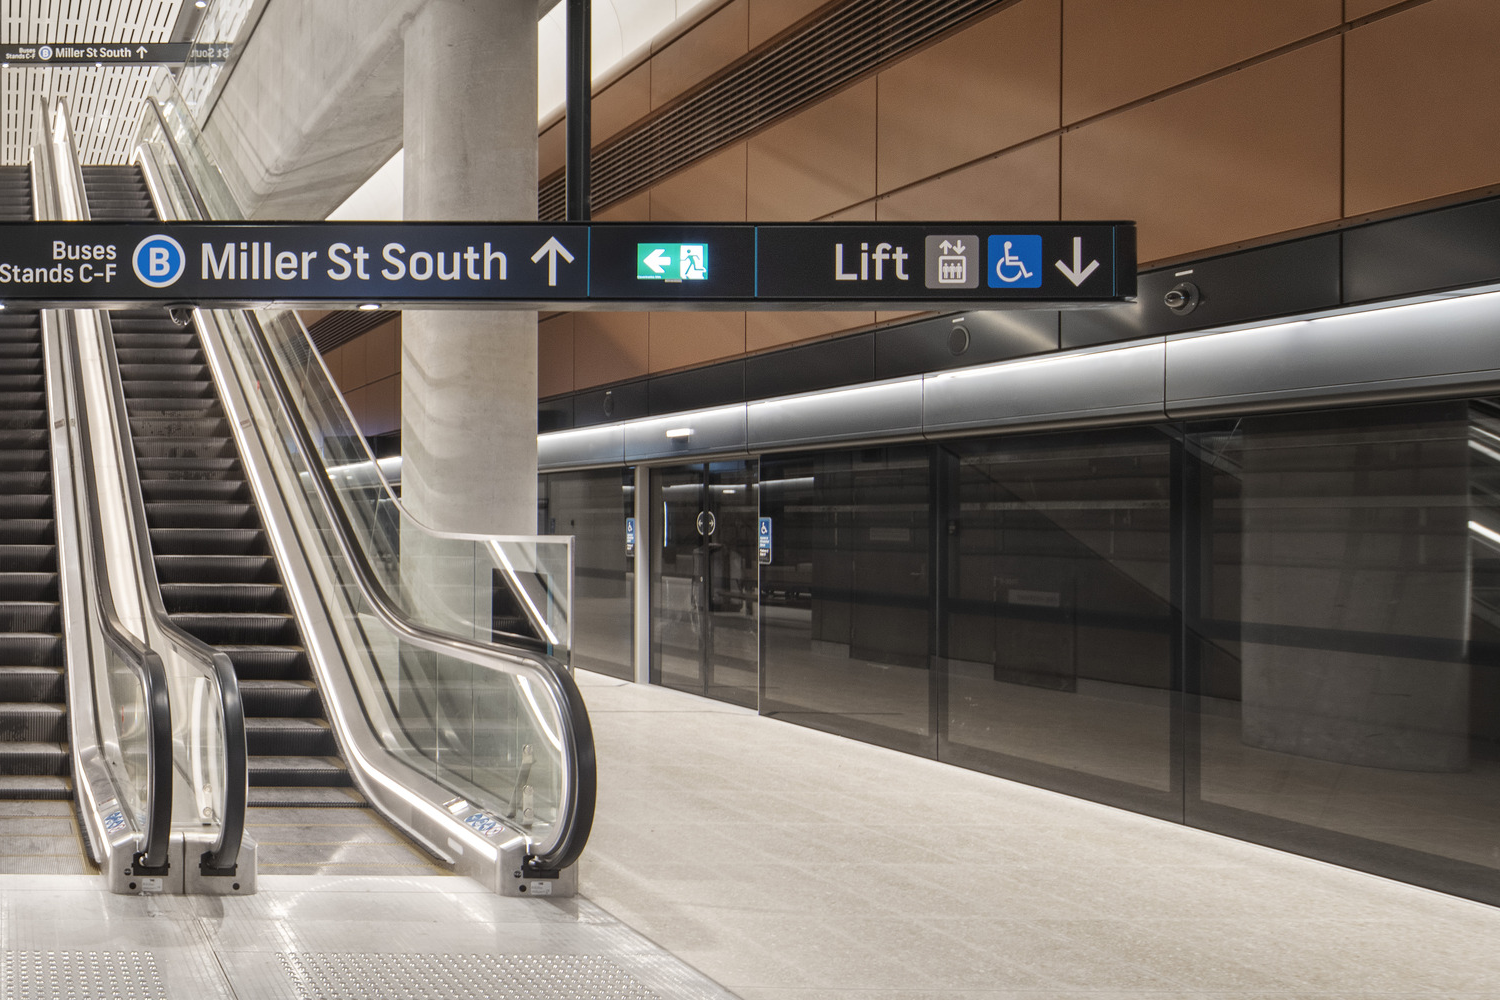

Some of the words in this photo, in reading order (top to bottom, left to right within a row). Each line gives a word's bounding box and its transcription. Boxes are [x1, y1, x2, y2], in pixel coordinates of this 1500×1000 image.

[55, 47, 85, 58] Miller
[86, 47, 98, 58] St
[99, 47, 132, 58] South
[52, 240, 117, 261] Buses
[149, 247, 170, 276] B
[201, 241, 317, 281] Miller
[326, 242, 371, 281] St
[381, 241, 507, 281] South
[835, 242, 909, 281] Lift
[79, 264, 117, 284] C-F
